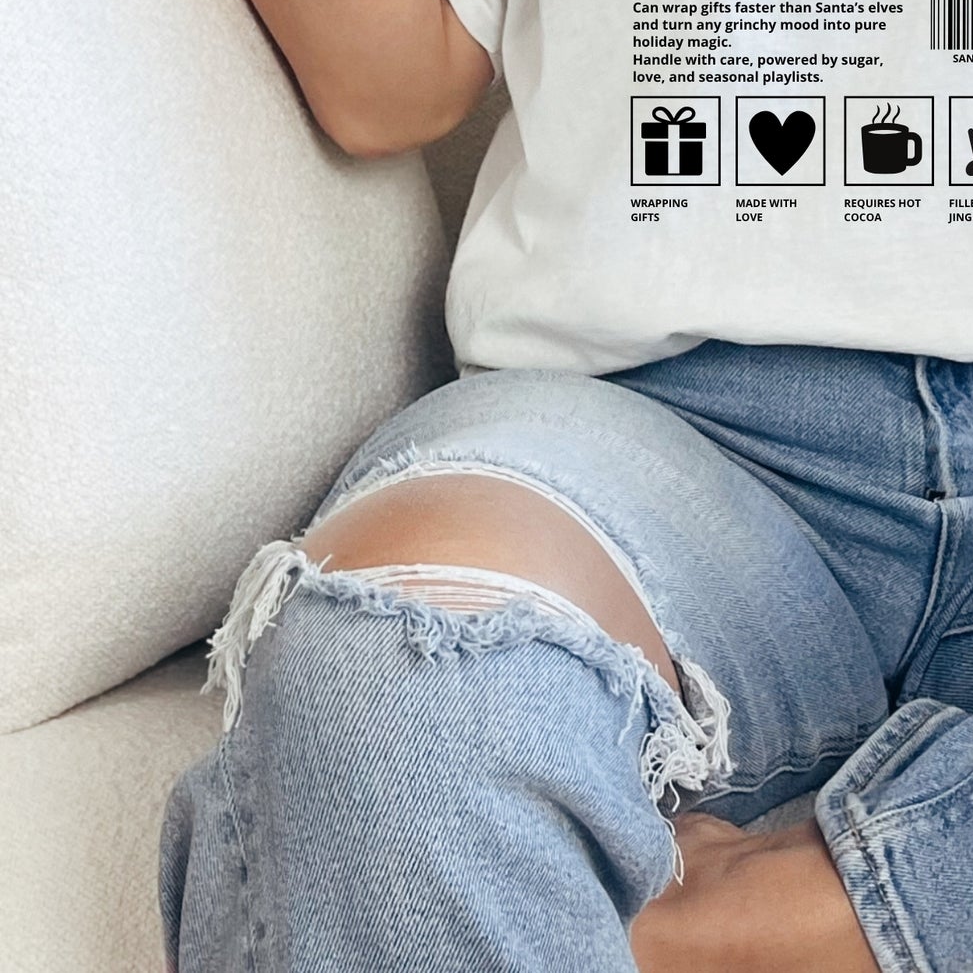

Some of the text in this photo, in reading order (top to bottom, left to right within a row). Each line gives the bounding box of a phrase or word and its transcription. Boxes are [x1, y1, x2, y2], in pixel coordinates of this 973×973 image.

[632, 1, 659, 14] Can
[661, 4, 698, 17] wrap
[700, 1, 732, 17] gifts
[734, 1, 776, 14] faster
[779, 1, 812, 14] than
[868, 1, 904, 14] elves
[632, 18, 887, 34] and turn any grinchy mood into pure
[633, 35, 732, 51] holiday magic.
[633, 53, 884, 69] Handle with care, powered by sugar,
[632, 70, 824, 86] love, and seasonal playlists.
[630, 198, 688, 208] WRAPPING
[735, 198, 797, 208] MADE WITH
[844, 198, 922, 210] REQUIRES HOT
[630, 212, 660, 222] GIFTS
[735, 212, 763, 222] LOVE
[844, 212, 882, 222] COCOA
